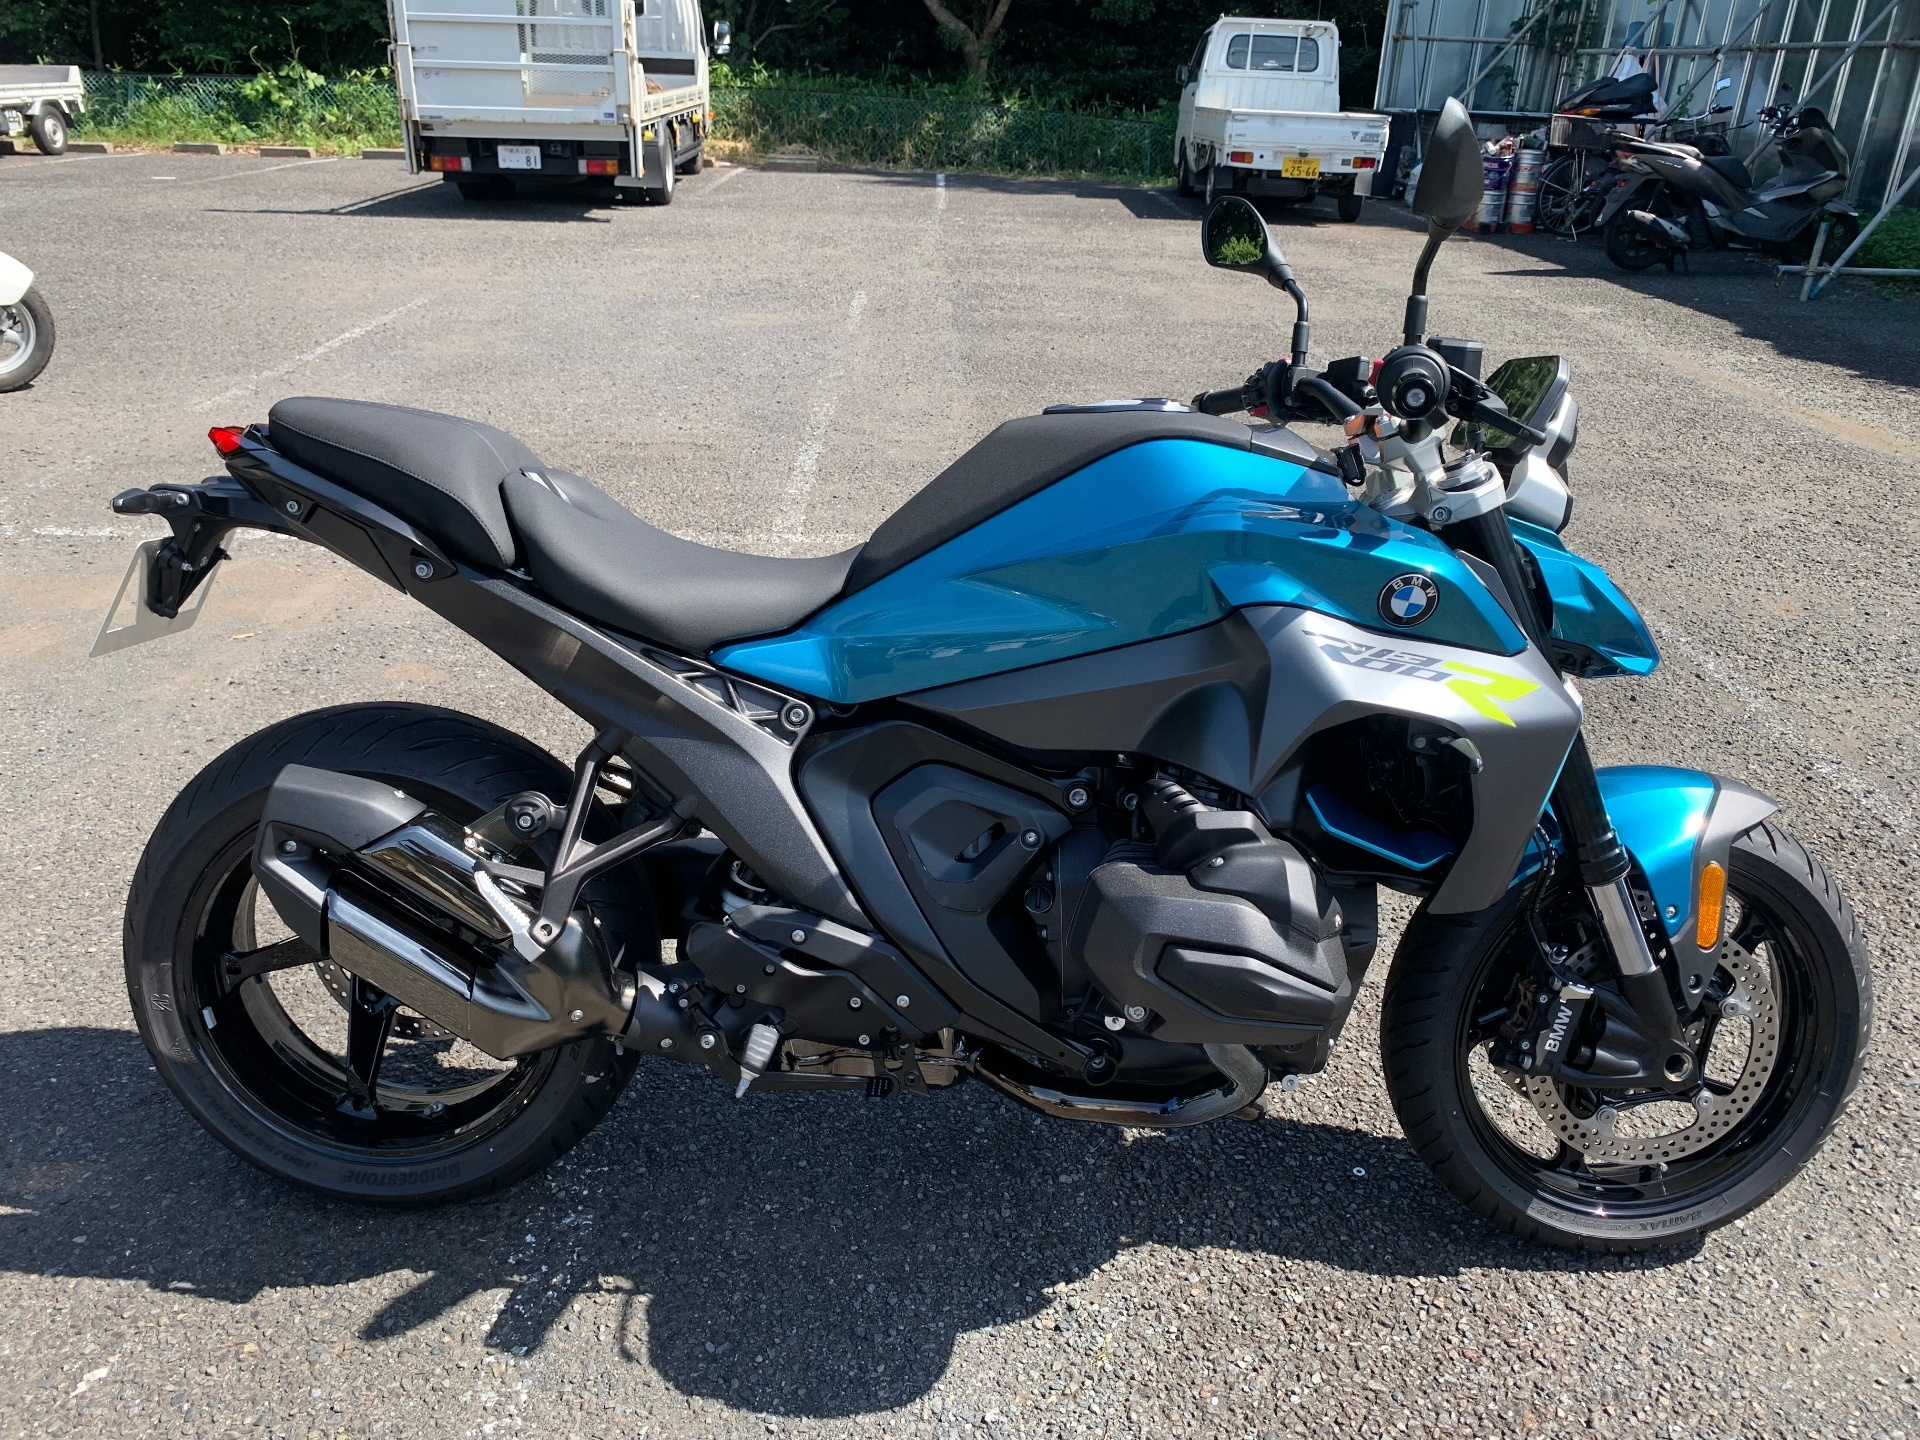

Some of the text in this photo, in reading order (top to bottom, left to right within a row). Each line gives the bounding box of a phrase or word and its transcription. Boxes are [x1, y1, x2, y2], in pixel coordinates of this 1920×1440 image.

[525, 155, 538, 167] 81
[1290, 165, 1317, 177] 25-66
[1392, 576, 1436, 598] BMW
[1544, 1005, 1573, 1053] BMW
[342, 1161, 461, 1187] BRIDGESTONE
